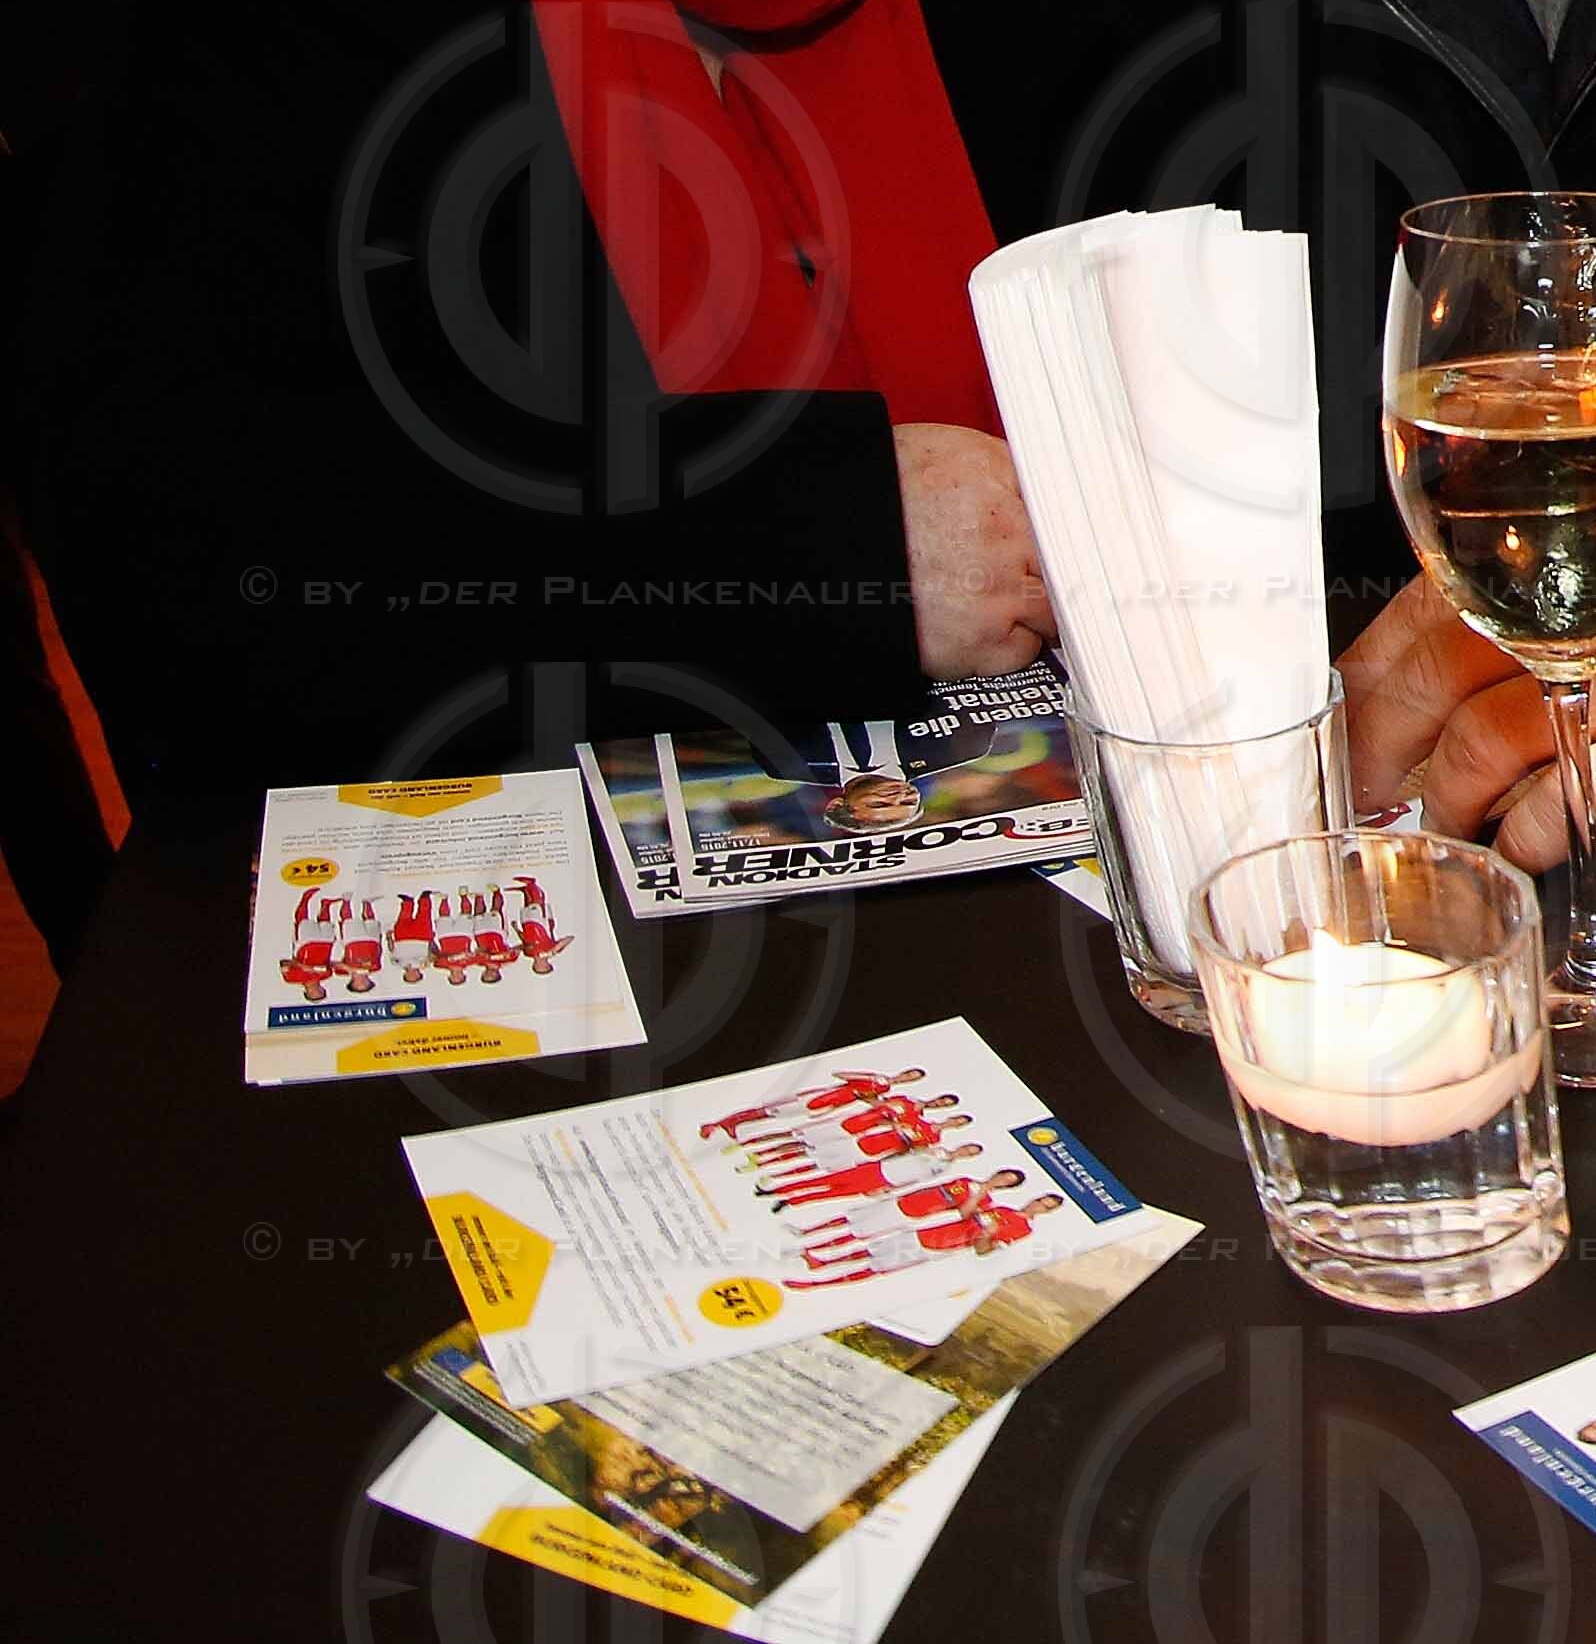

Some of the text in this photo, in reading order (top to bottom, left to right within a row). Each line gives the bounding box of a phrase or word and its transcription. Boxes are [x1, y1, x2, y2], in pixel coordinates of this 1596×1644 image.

[942, 682, 1066, 712] Heimat
[907, 713, 961, 739] die
[692, 816, 1016, 877] CORNER
[305, 862, 330, 876] 54
[708, 854, 906, 888] STADION
